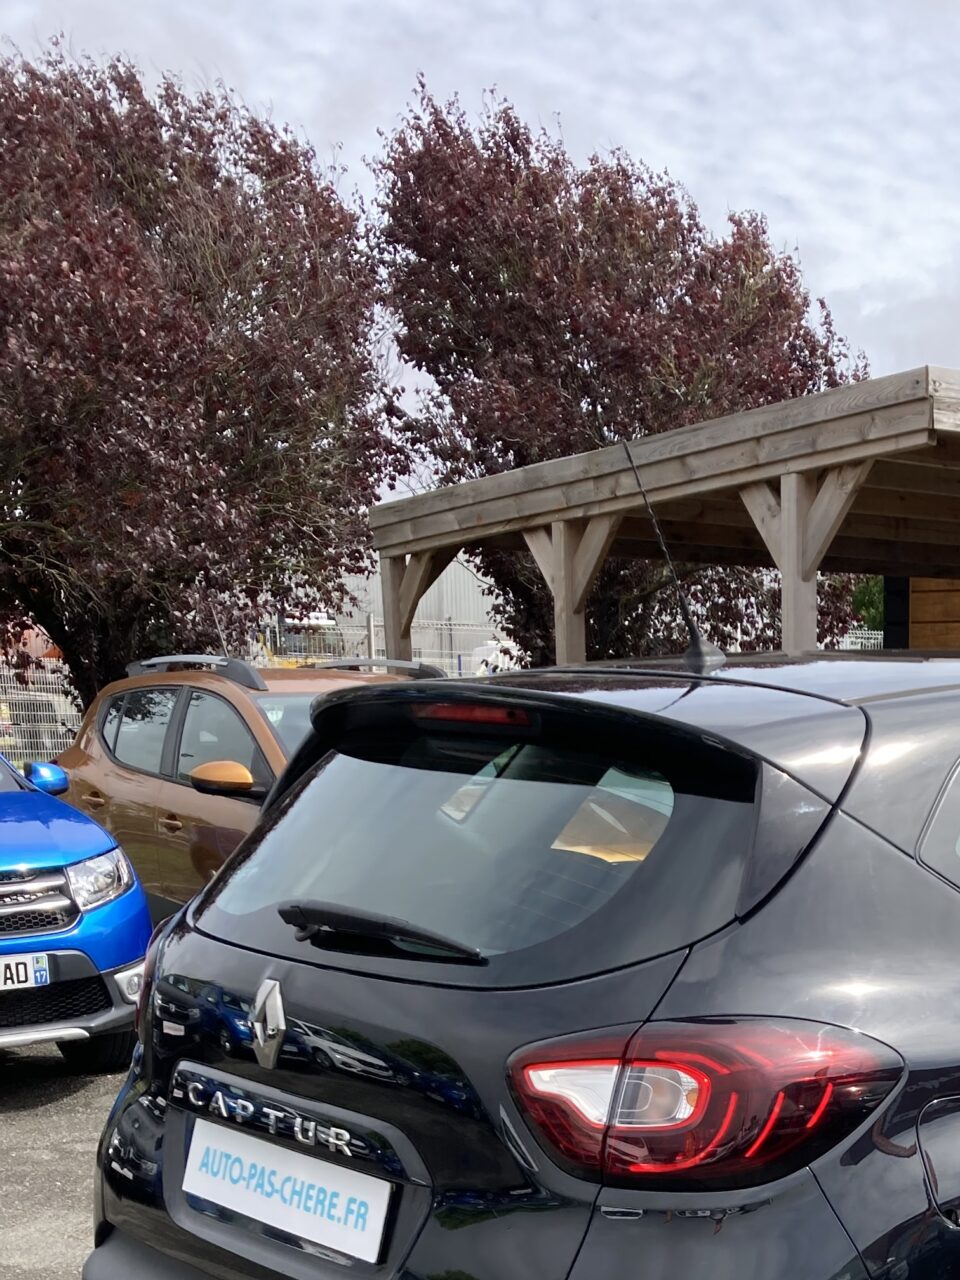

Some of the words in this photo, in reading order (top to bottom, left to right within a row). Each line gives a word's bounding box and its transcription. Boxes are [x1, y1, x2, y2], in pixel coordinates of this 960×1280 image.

[3, 961, 29, 986] AD
[35, 970, 47, 983] 17
[188, 1082, 353, 1157] CAPTUR
[198, 1146, 369, 1232] AUTO-PAS-CHERE.FR
